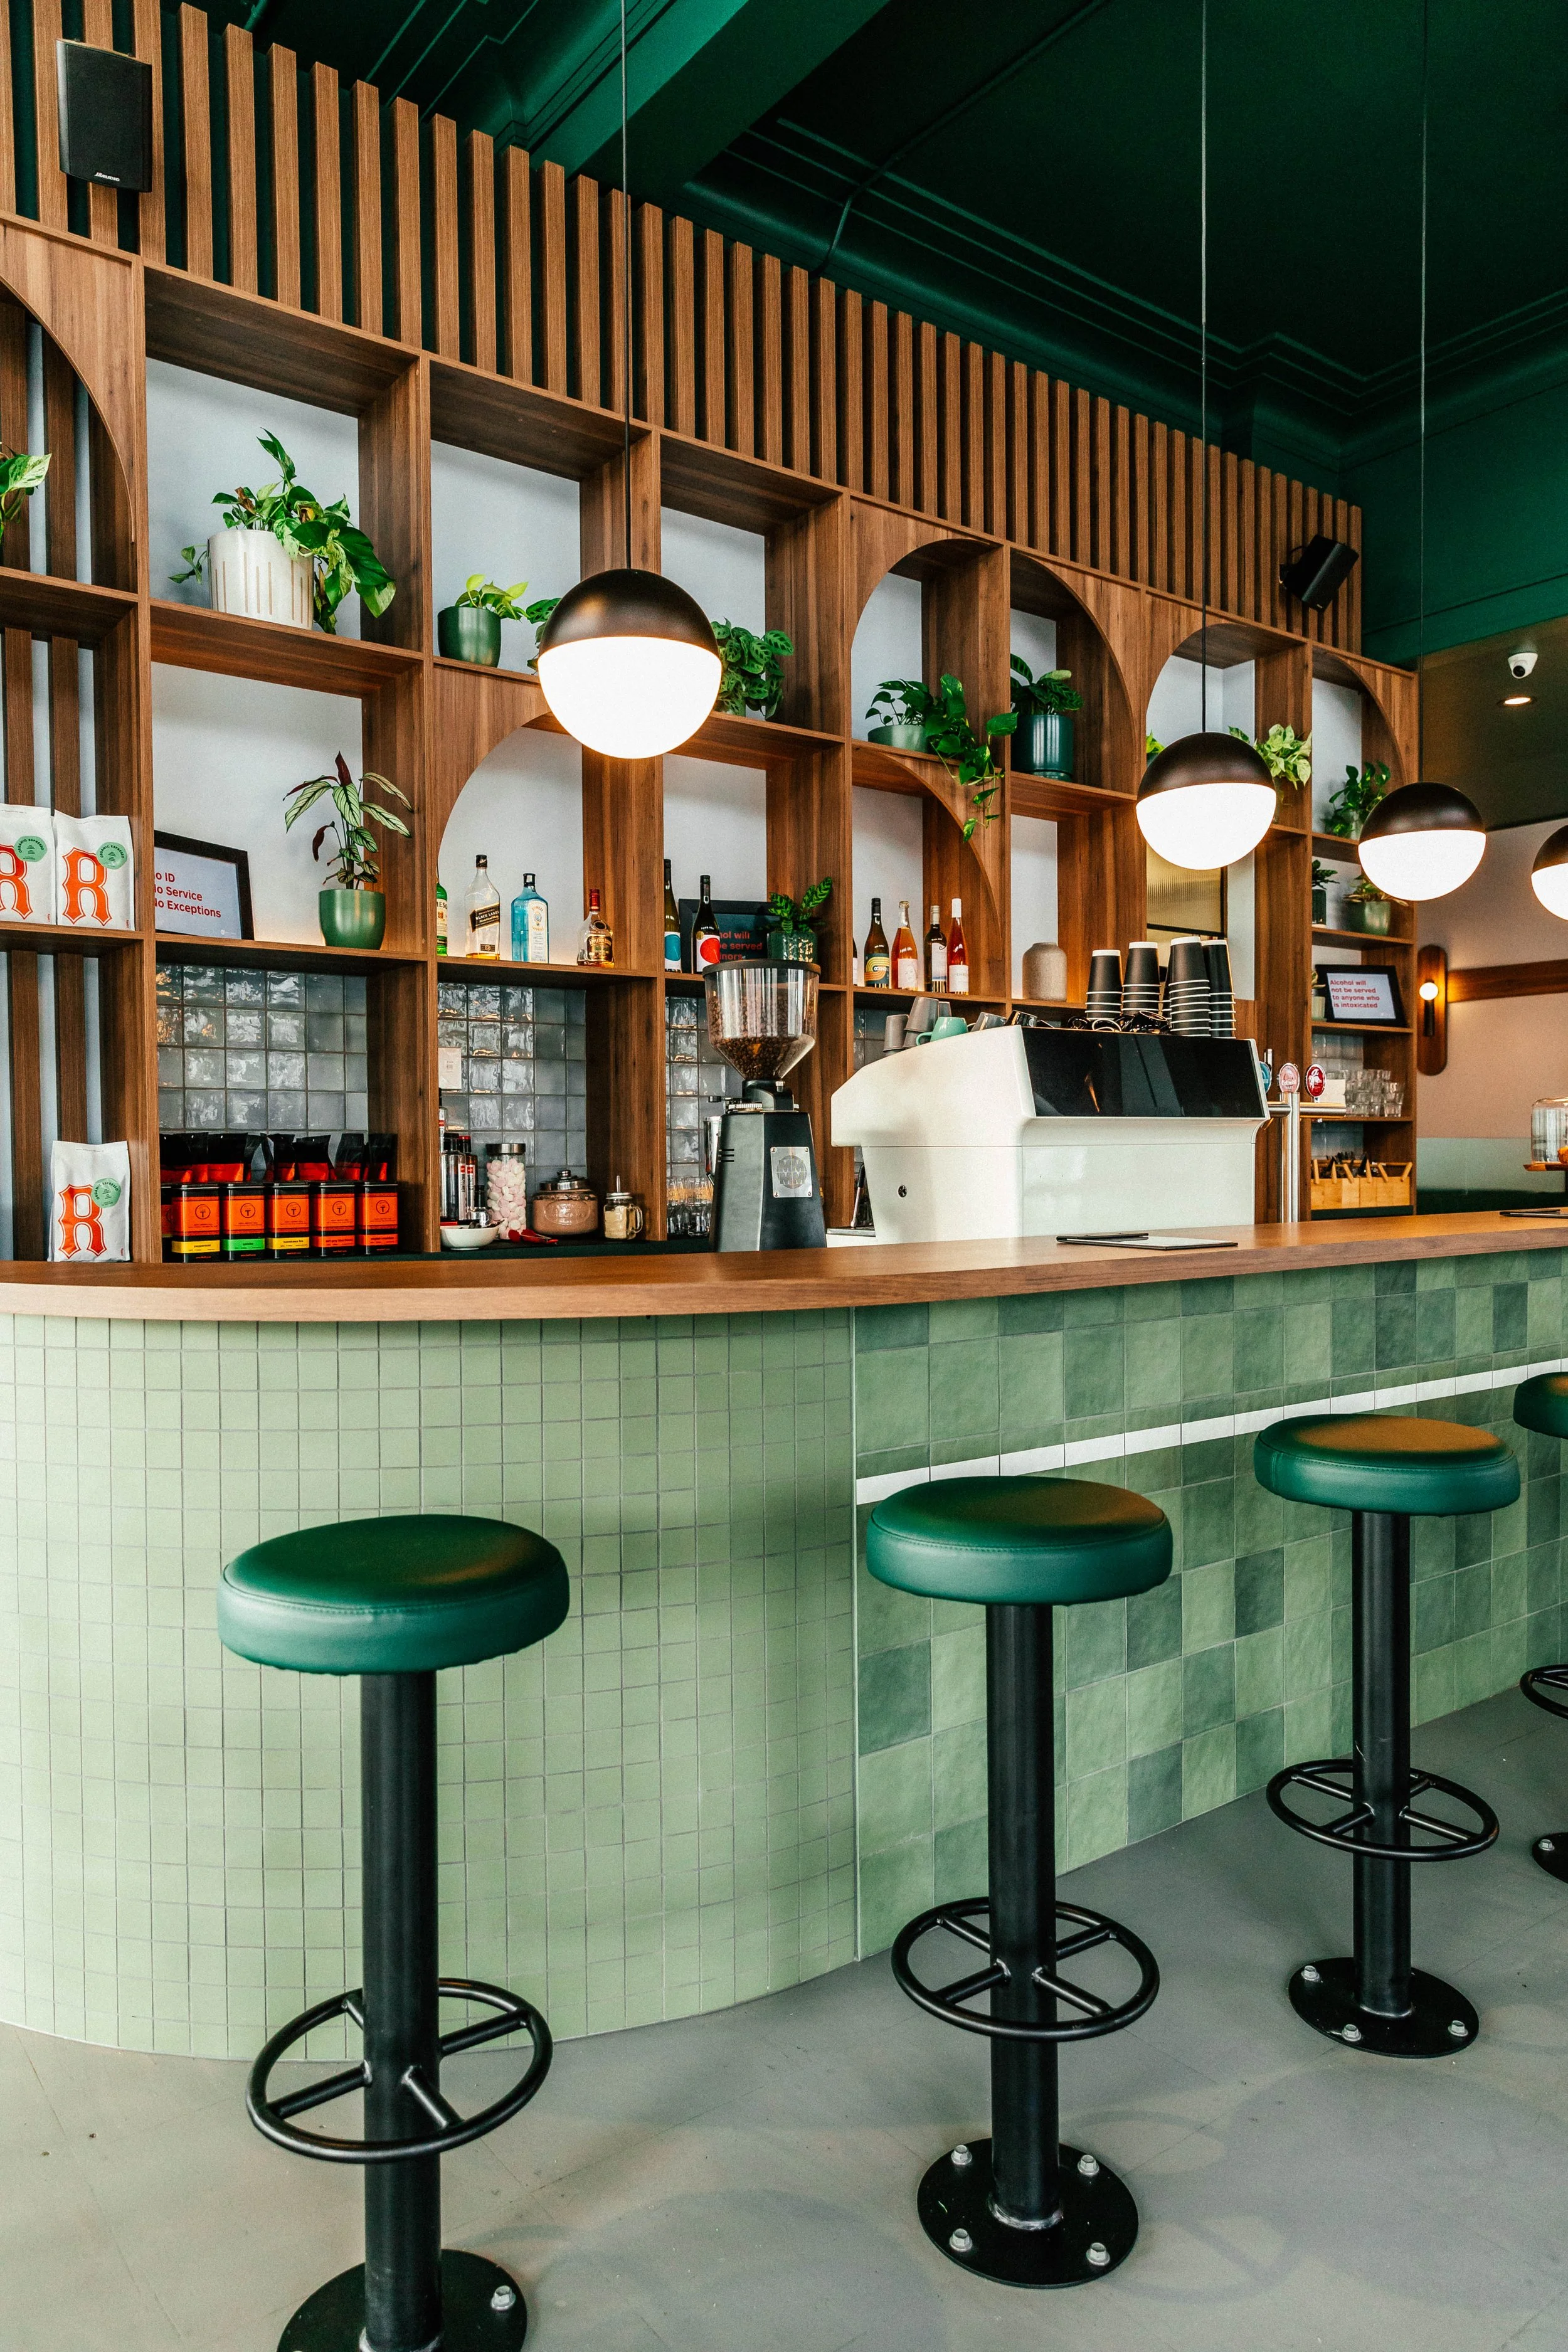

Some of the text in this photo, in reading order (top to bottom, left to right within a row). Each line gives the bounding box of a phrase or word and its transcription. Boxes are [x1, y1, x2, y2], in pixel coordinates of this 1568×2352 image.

[165, 872, 175, 882] ID
[61, 847, 112, 926] R
[166, 886, 203, 901] Service
[167, 900, 221, 918] Exceptions
[58, 1184, 107, 1259] R
